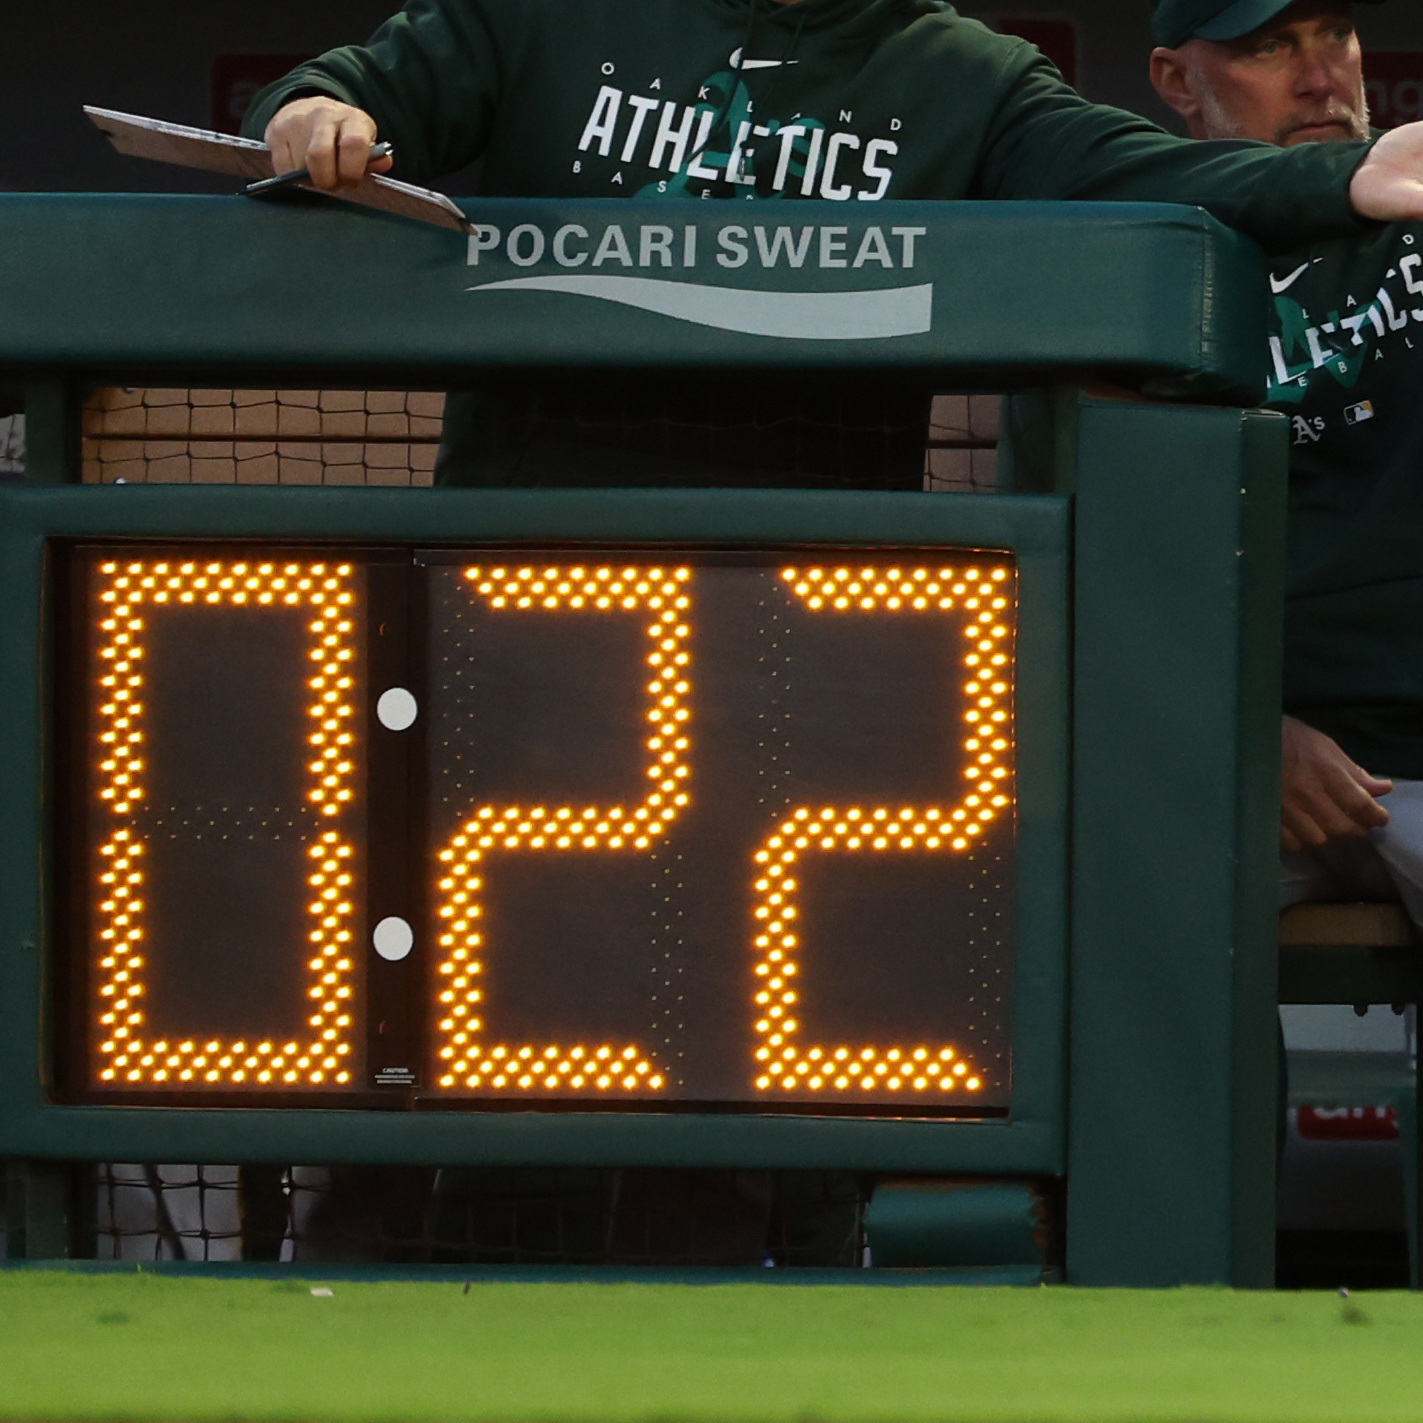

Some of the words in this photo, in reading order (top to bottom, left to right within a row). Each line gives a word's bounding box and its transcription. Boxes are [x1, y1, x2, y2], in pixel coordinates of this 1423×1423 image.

[466, 224, 697, 268] POCARI
[716, 225, 927, 269] SWEAT
[1291, 414, 1326, 446] A's
